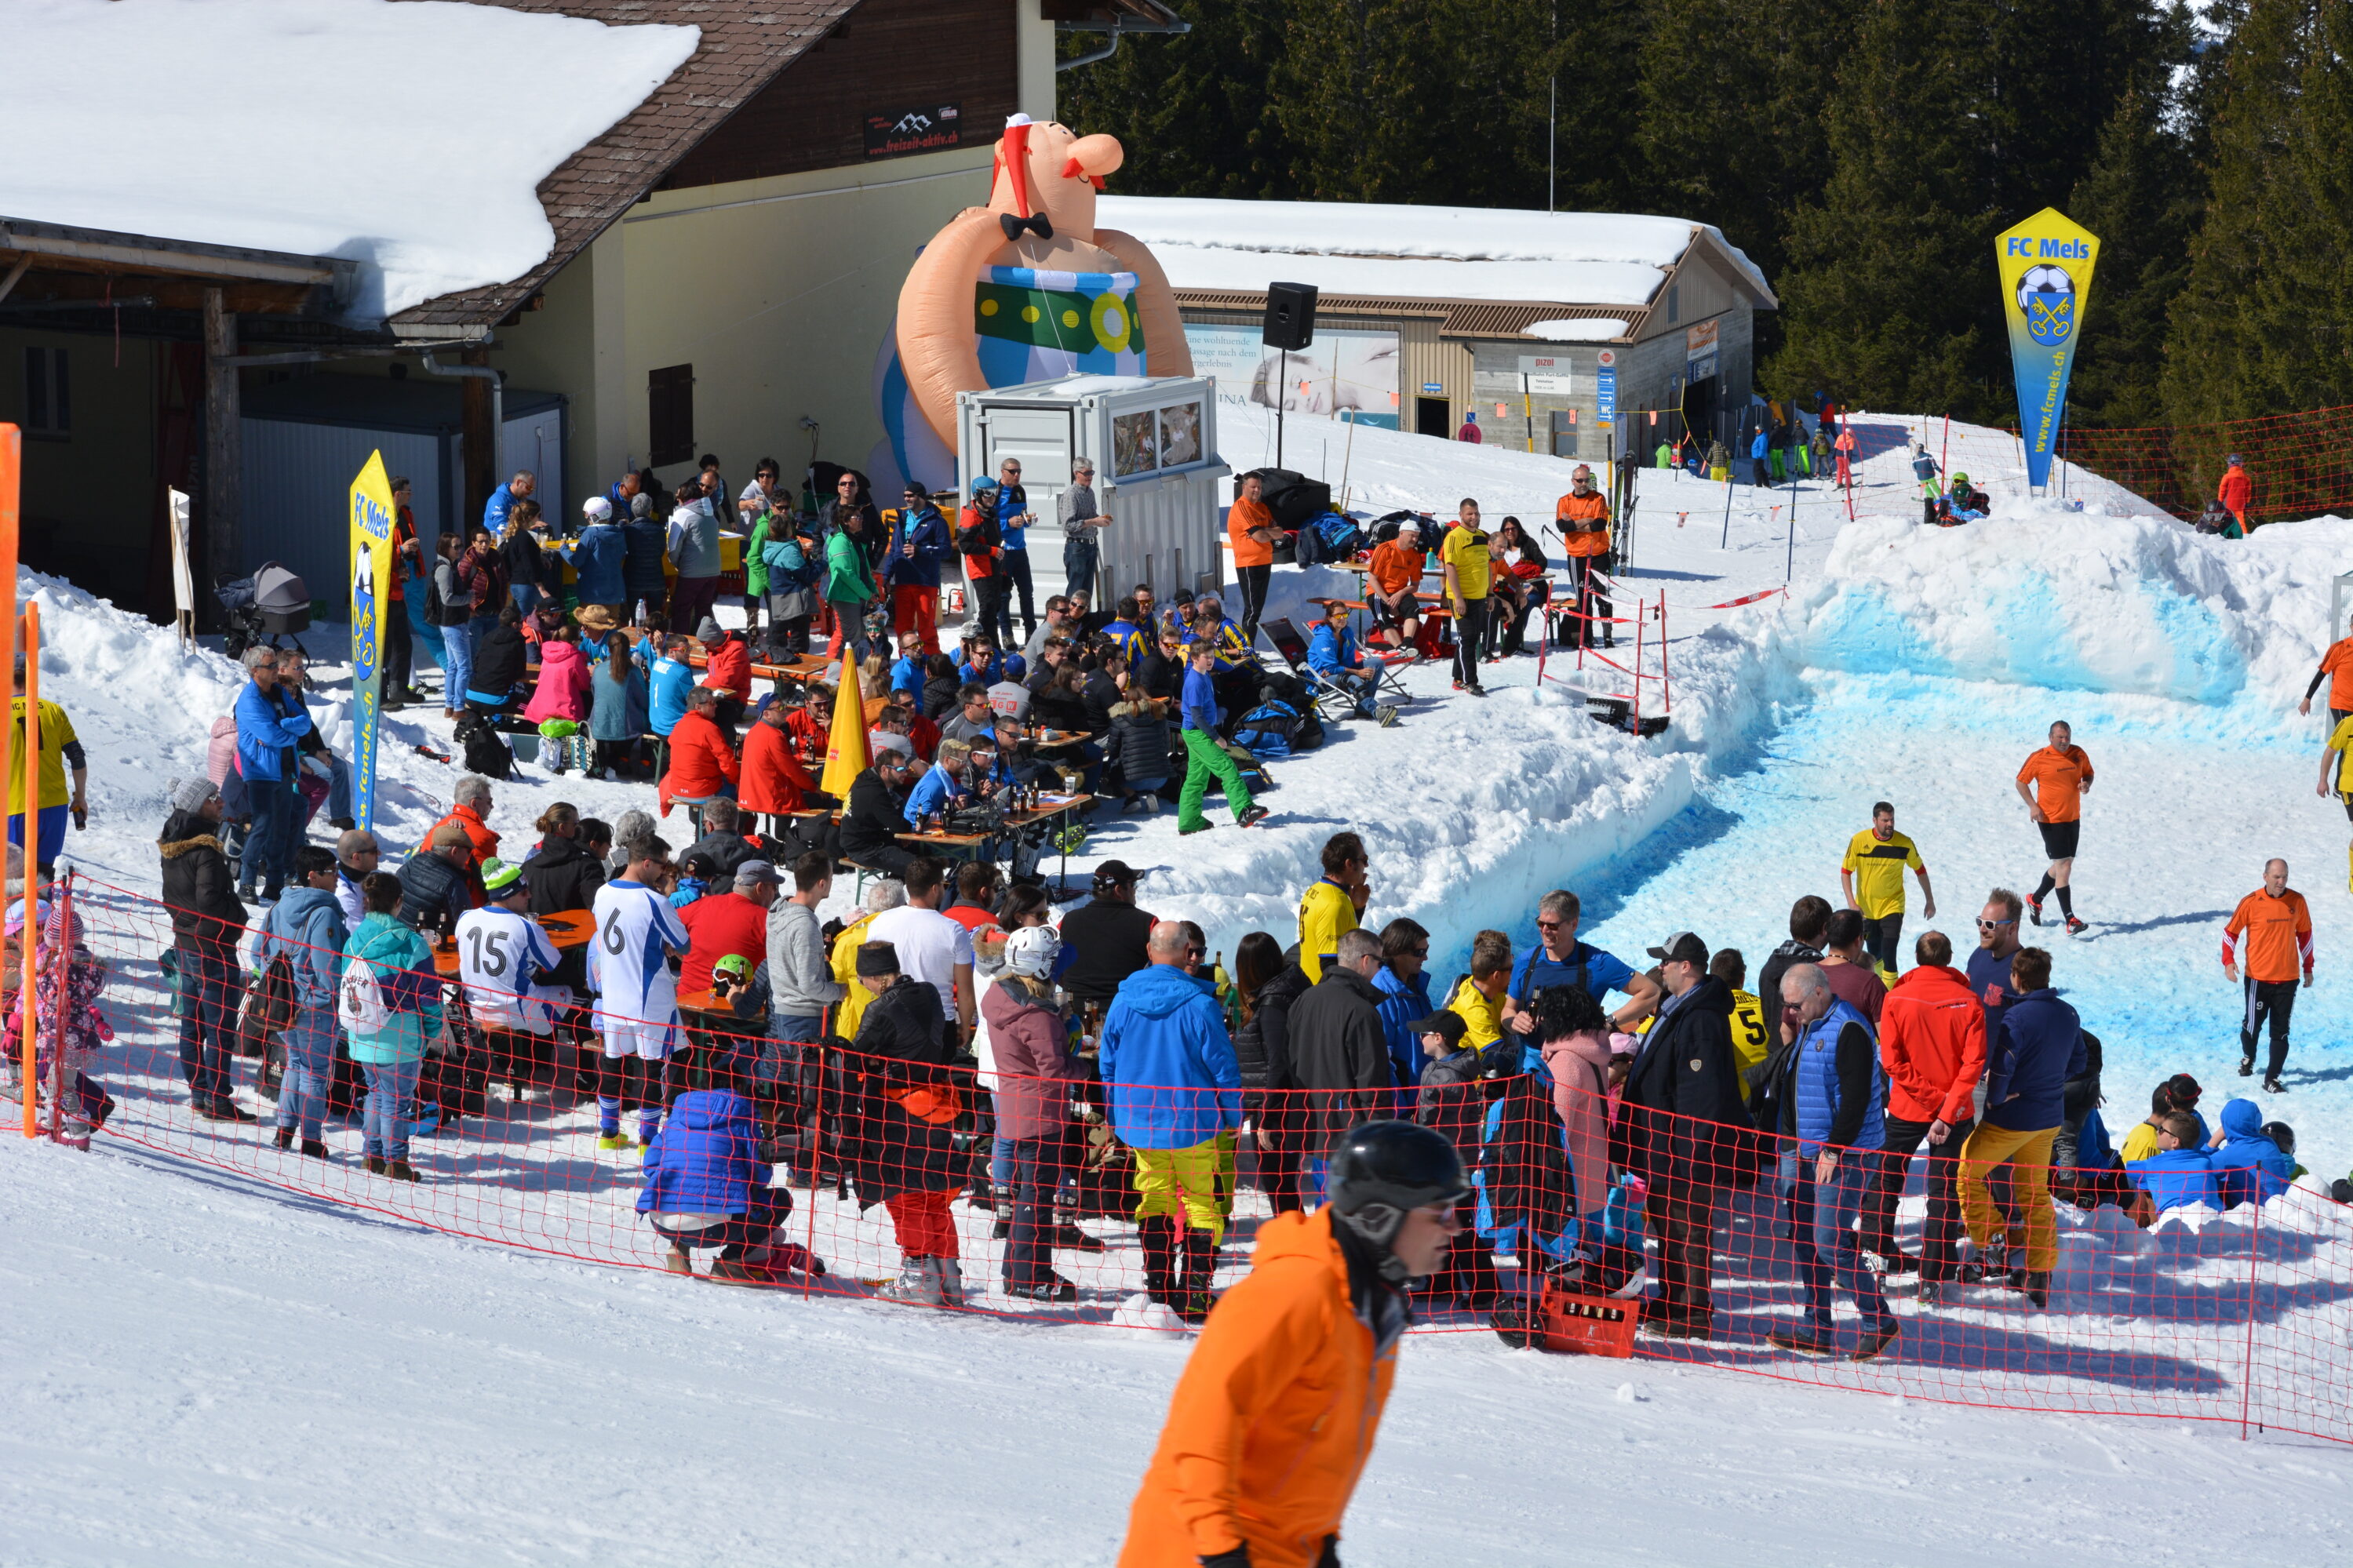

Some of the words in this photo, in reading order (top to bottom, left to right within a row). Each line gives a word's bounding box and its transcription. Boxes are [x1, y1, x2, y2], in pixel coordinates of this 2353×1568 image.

[869, 130, 958, 155] www.freizeit-aktiv.ch
[2007, 237, 2033, 257] FC
[2038, 238, 2090, 260] Mels
[1189, 347, 1215, 357] assage
[1218, 347, 1237, 357] nach
[1239, 348, 1256, 357] dem
[1204, 336, 1251, 345] wohltuende
[1535, 358, 1554, 367] pizol
[1601, 406, 1612, 414] WC
[2034, 351, 2066, 453] www.fcmels.ch
[355, 491, 365, 528] FC
[365, 500, 390, 540] Mels
[359, 691, 373, 831] ww.fcmels.ch
[603, 907, 625, 955] 6
[467, 926, 509, 977] 15
[2256, 1001, 2264, 1010] 9
[1737, 1009, 1767, 1046] 5
